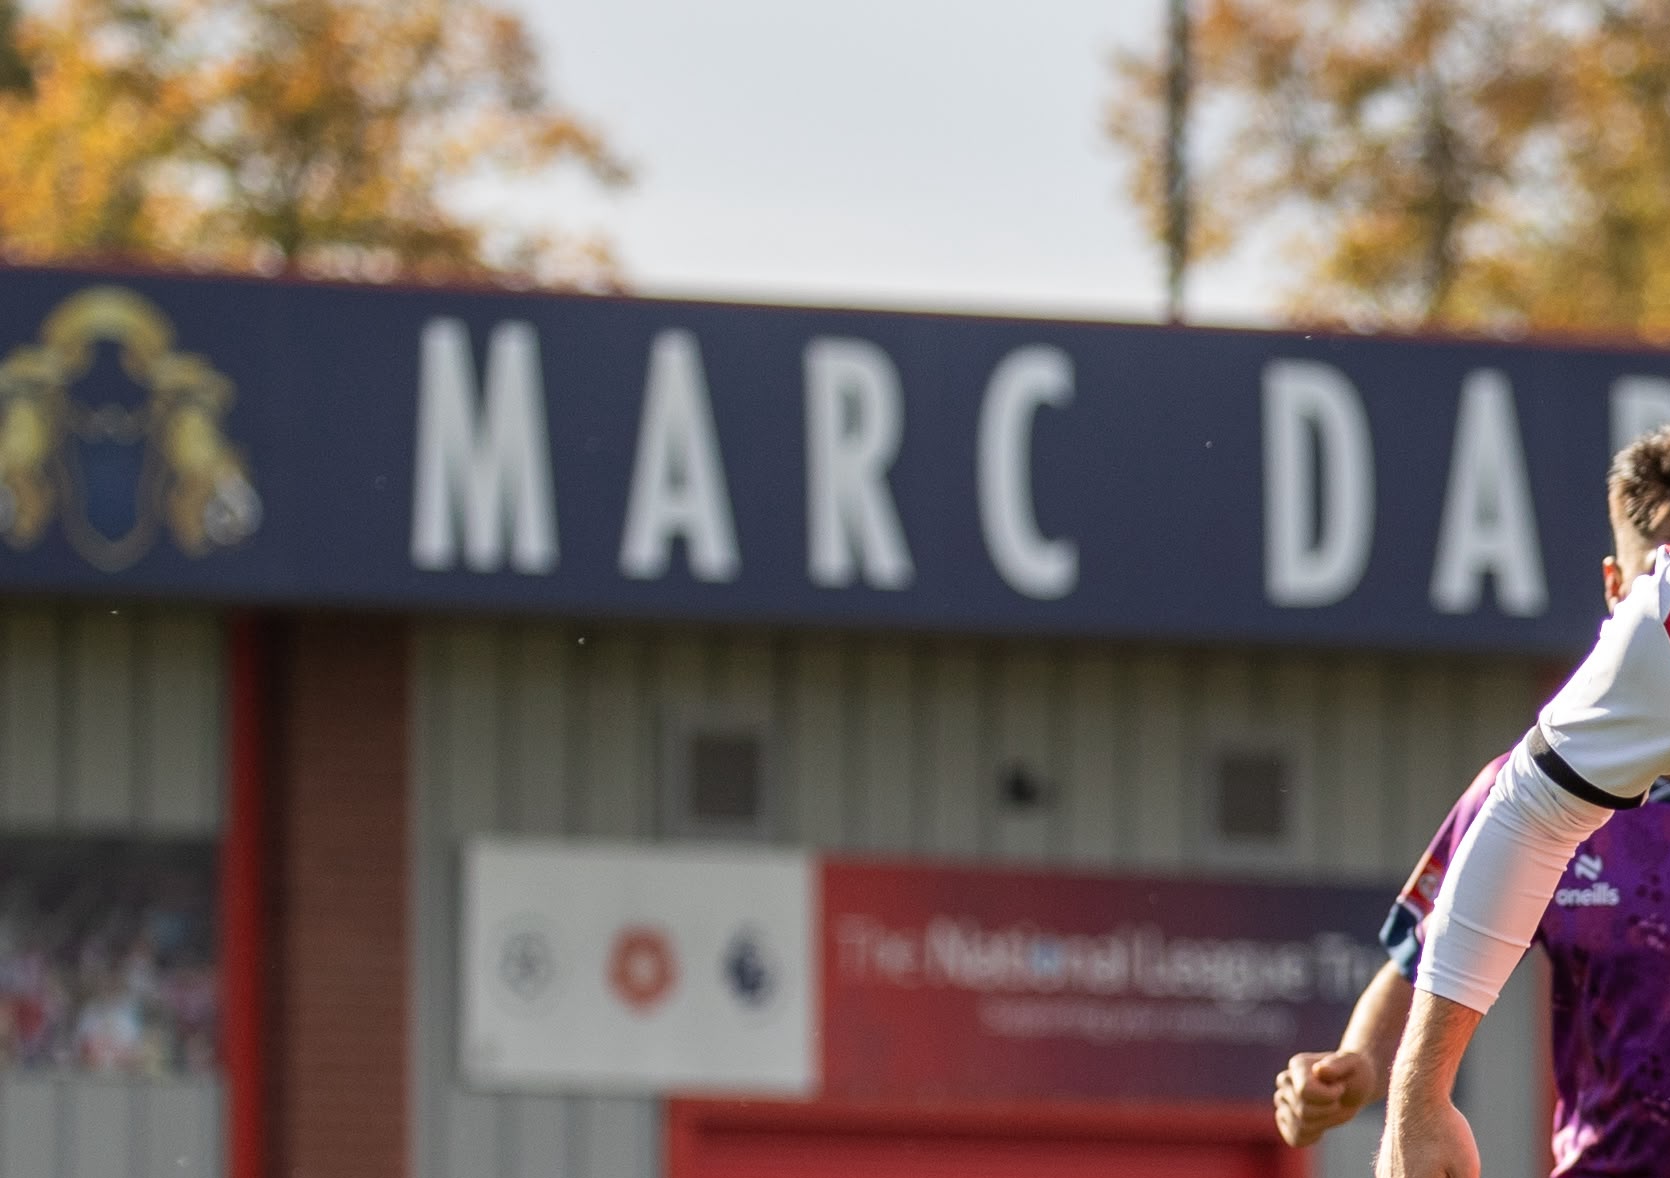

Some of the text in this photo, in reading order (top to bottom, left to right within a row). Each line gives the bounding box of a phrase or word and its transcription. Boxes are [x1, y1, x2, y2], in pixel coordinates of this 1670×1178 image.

[411, 316, 1078, 598] MARC
[1555, 882, 1620, 907] oneills
[931, 921, 1137, 989] National
[1142, 930, 1306, 1006] League
